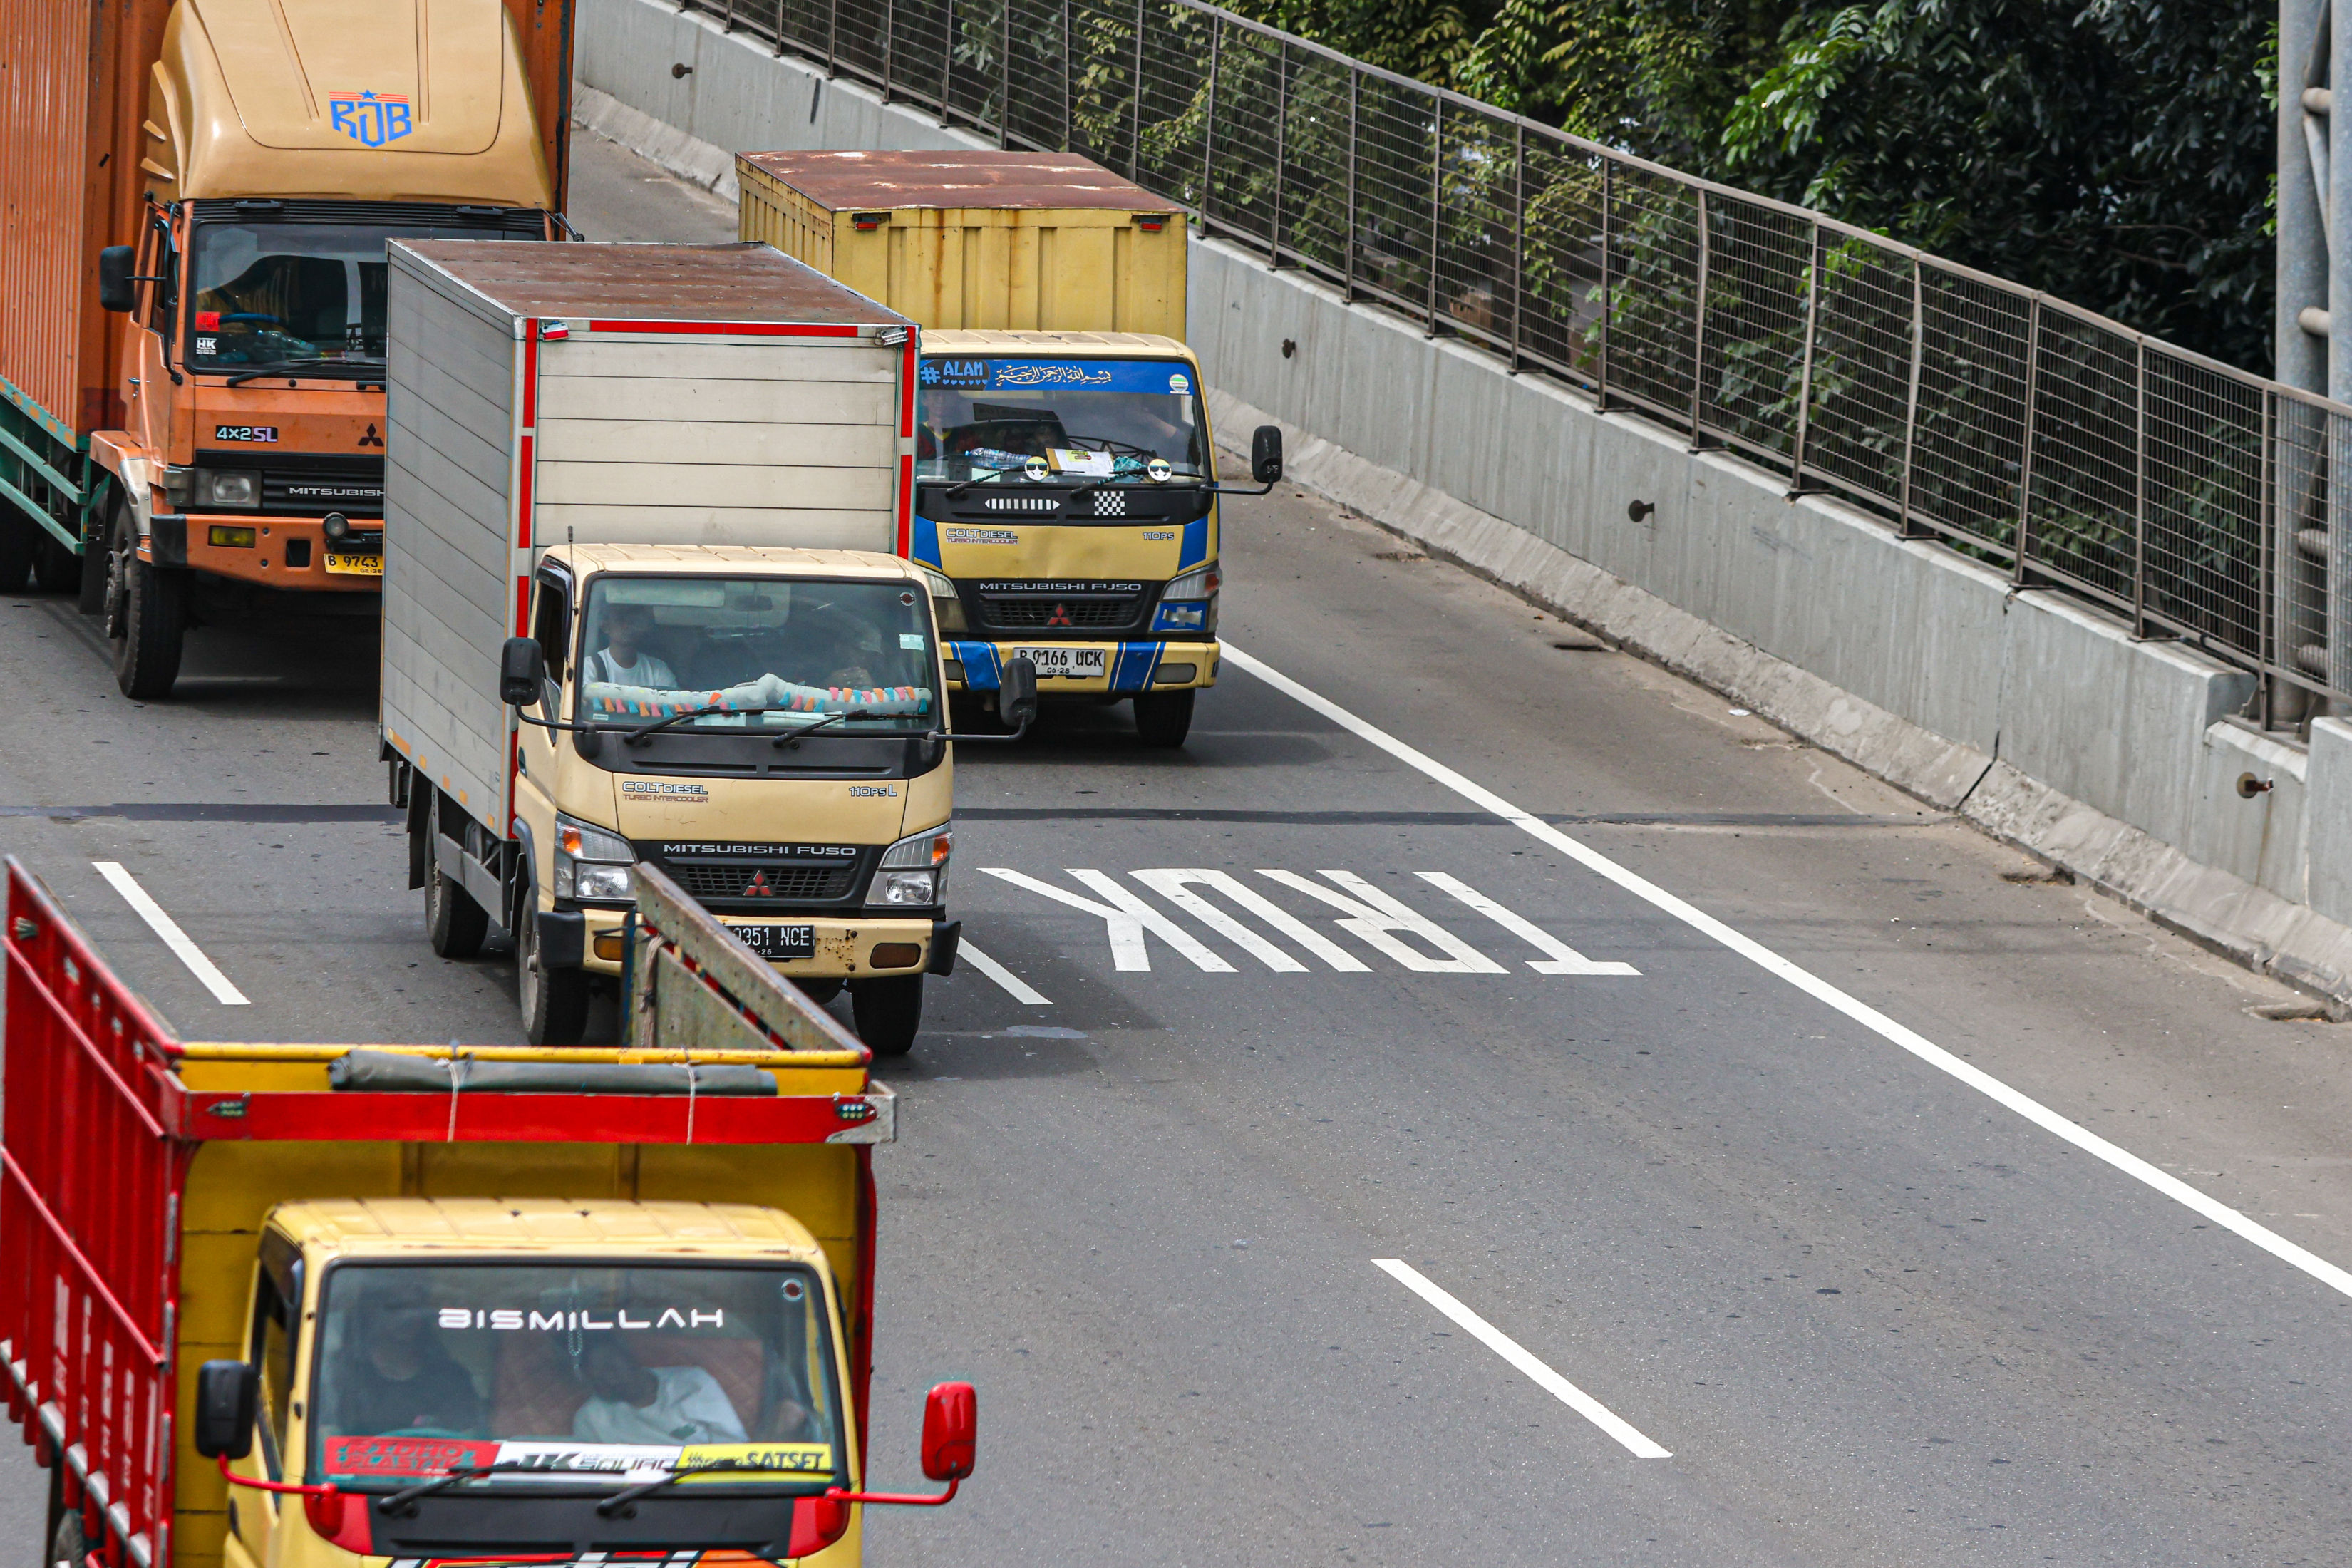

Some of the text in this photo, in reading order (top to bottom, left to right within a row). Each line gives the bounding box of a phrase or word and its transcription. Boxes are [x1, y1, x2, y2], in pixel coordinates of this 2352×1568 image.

[330, 100, 412, 148] RJB
[1143, 532, 1175, 540] 110PS
[664, 844, 856, 855] MITSUBISHI FUSO
[976, 867, 1644, 976] TRUK
[780, 927, 810, 946] NCE
[438, 1307, 723, 1331] BISMILLAH
